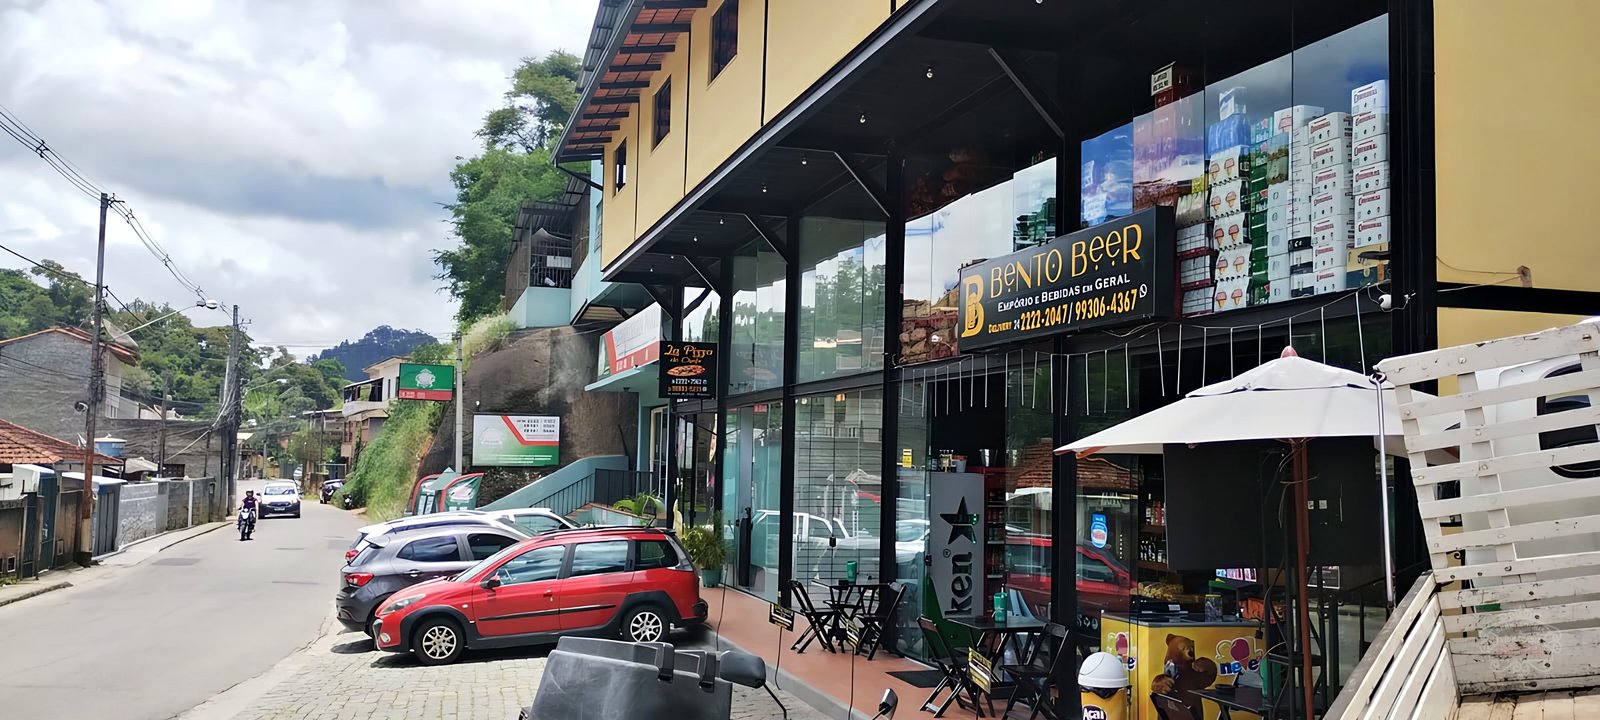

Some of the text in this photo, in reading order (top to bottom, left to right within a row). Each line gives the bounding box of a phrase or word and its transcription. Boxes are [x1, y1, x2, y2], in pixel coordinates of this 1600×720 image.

[1041, 286, 1081, 302] BEBIDAS
[1095, 273, 1131, 290] GERAL
[1075, 288, 1138, 321] 99306-4367
[683, 344, 713, 358] Pizza
